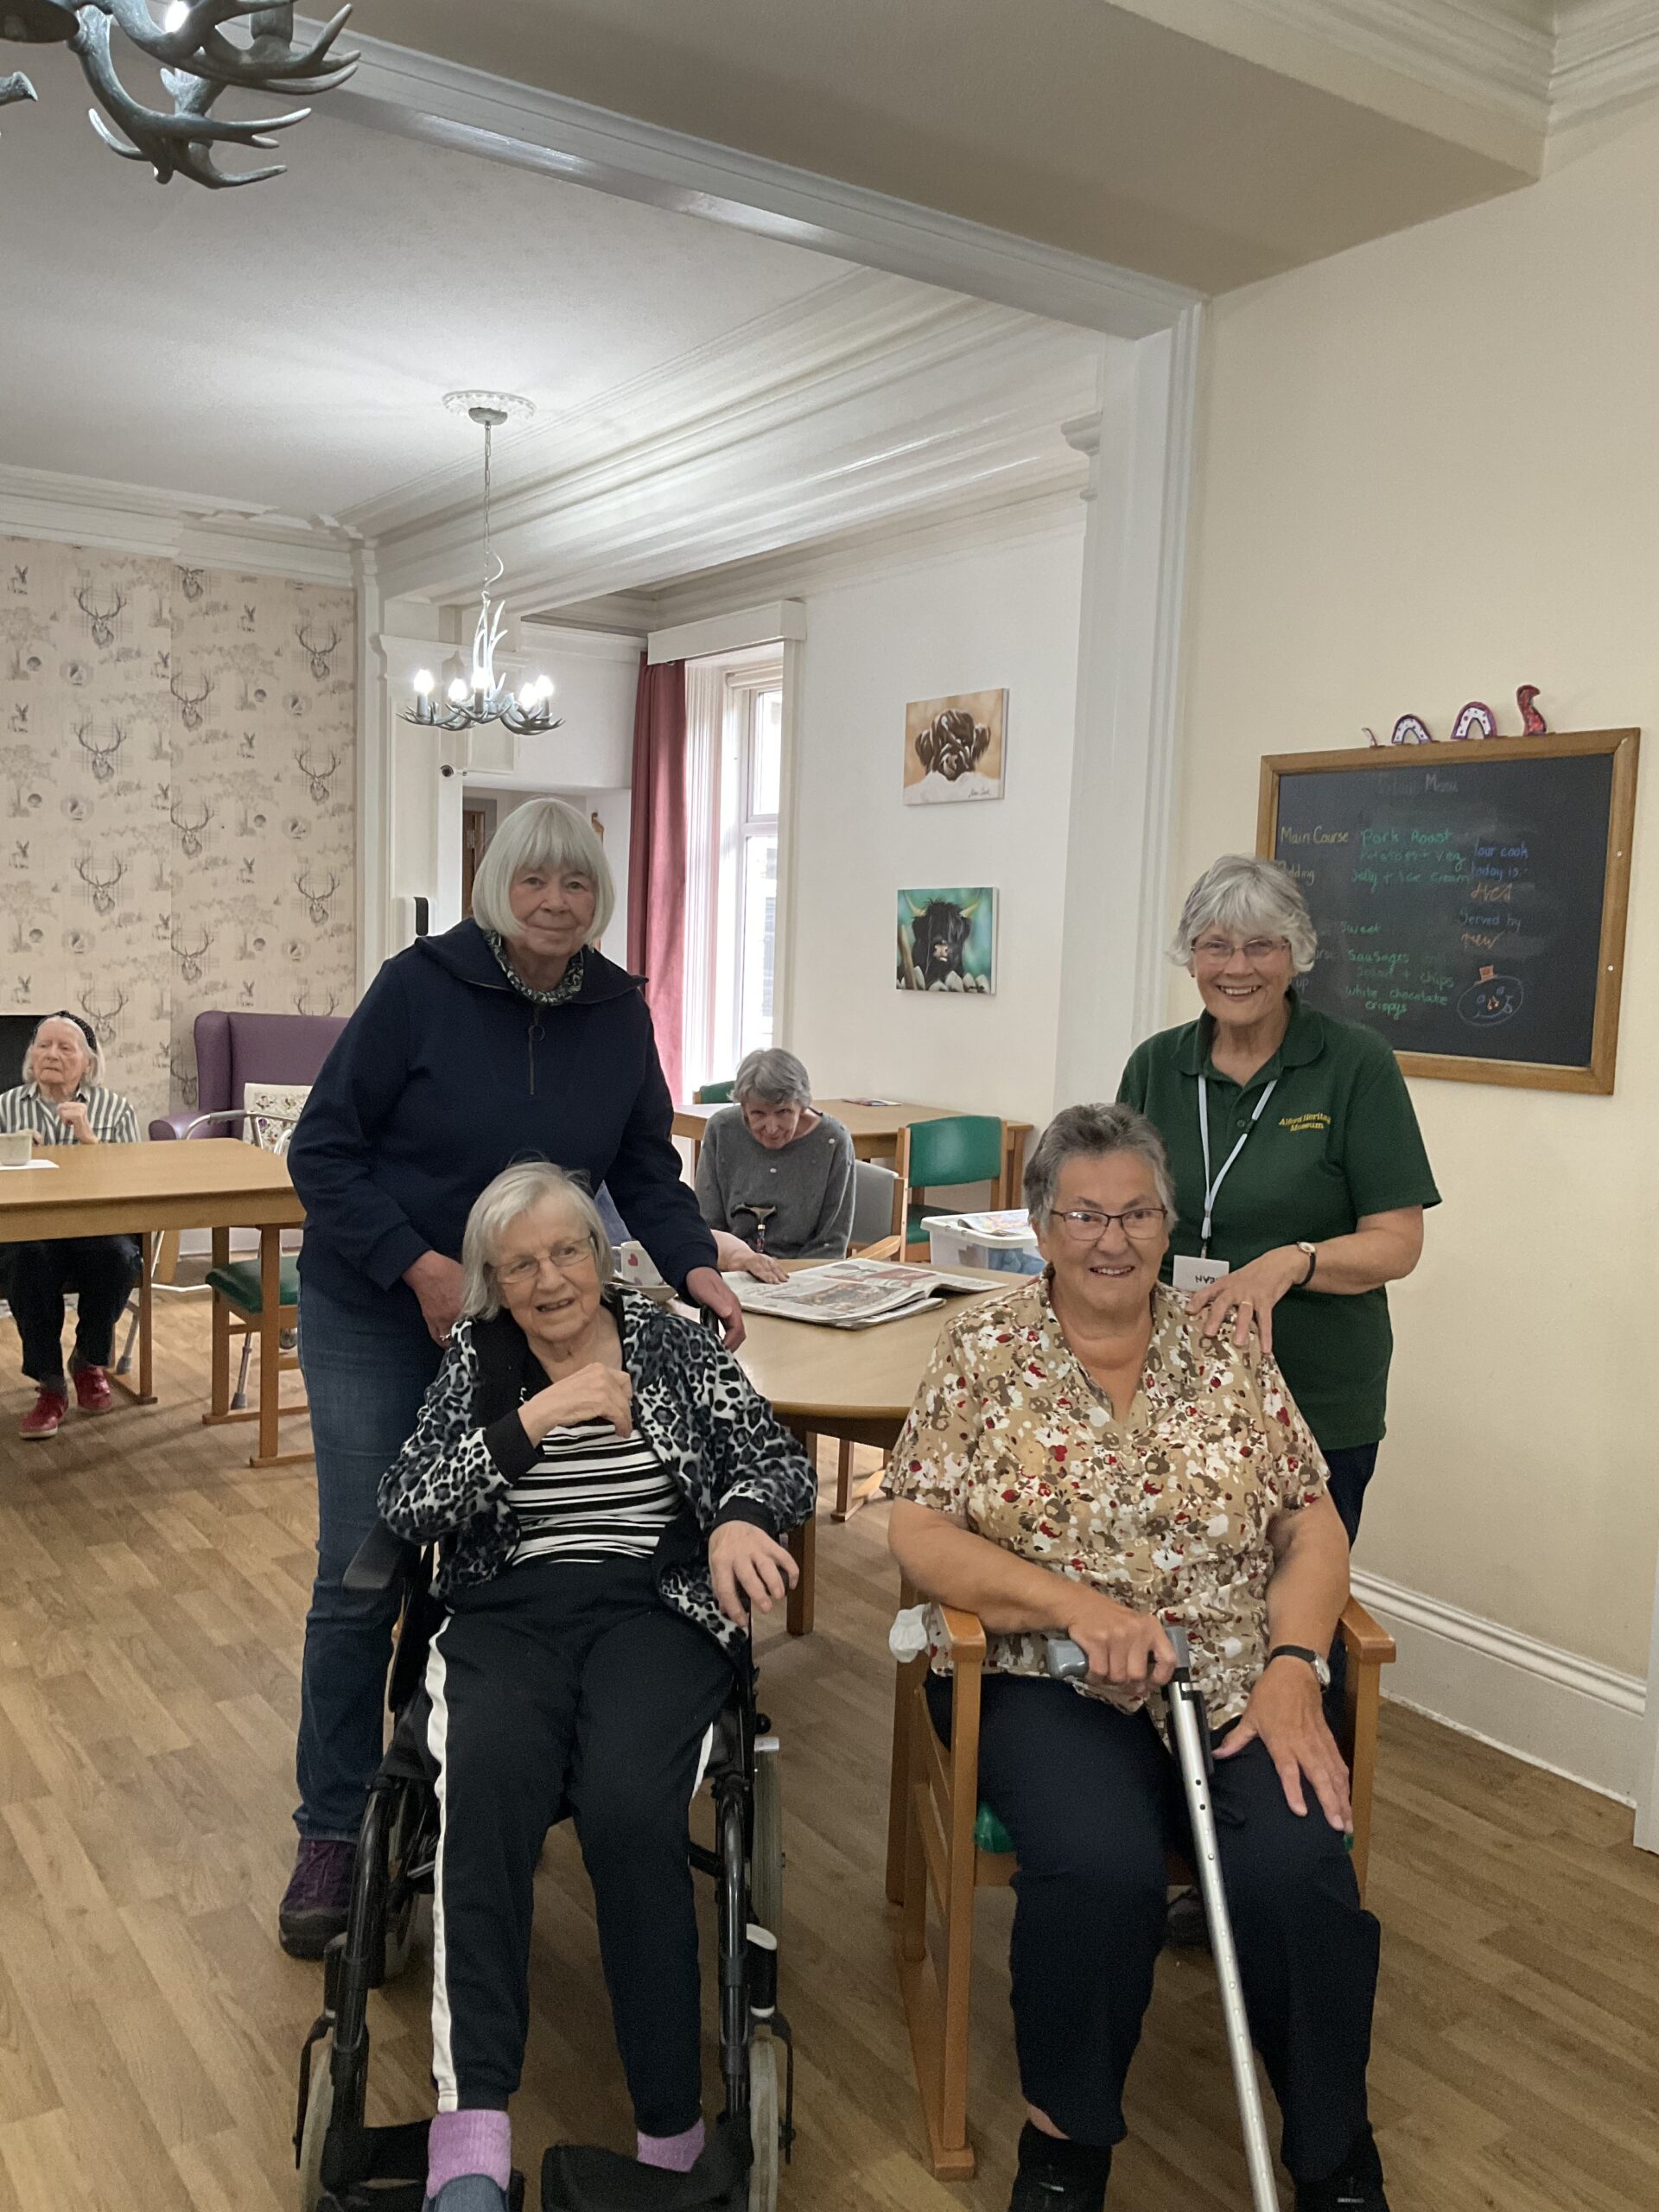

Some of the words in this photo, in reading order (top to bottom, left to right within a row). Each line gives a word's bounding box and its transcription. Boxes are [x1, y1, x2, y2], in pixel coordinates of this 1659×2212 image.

[1281, 826, 1310, 844] Main
[1313, 825, 1349, 844] Course
[1361, 829, 1399, 847] Pork
[1411, 828, 1452, 844] Roast
[1303, 1111, 1332, 1125] Heritag
